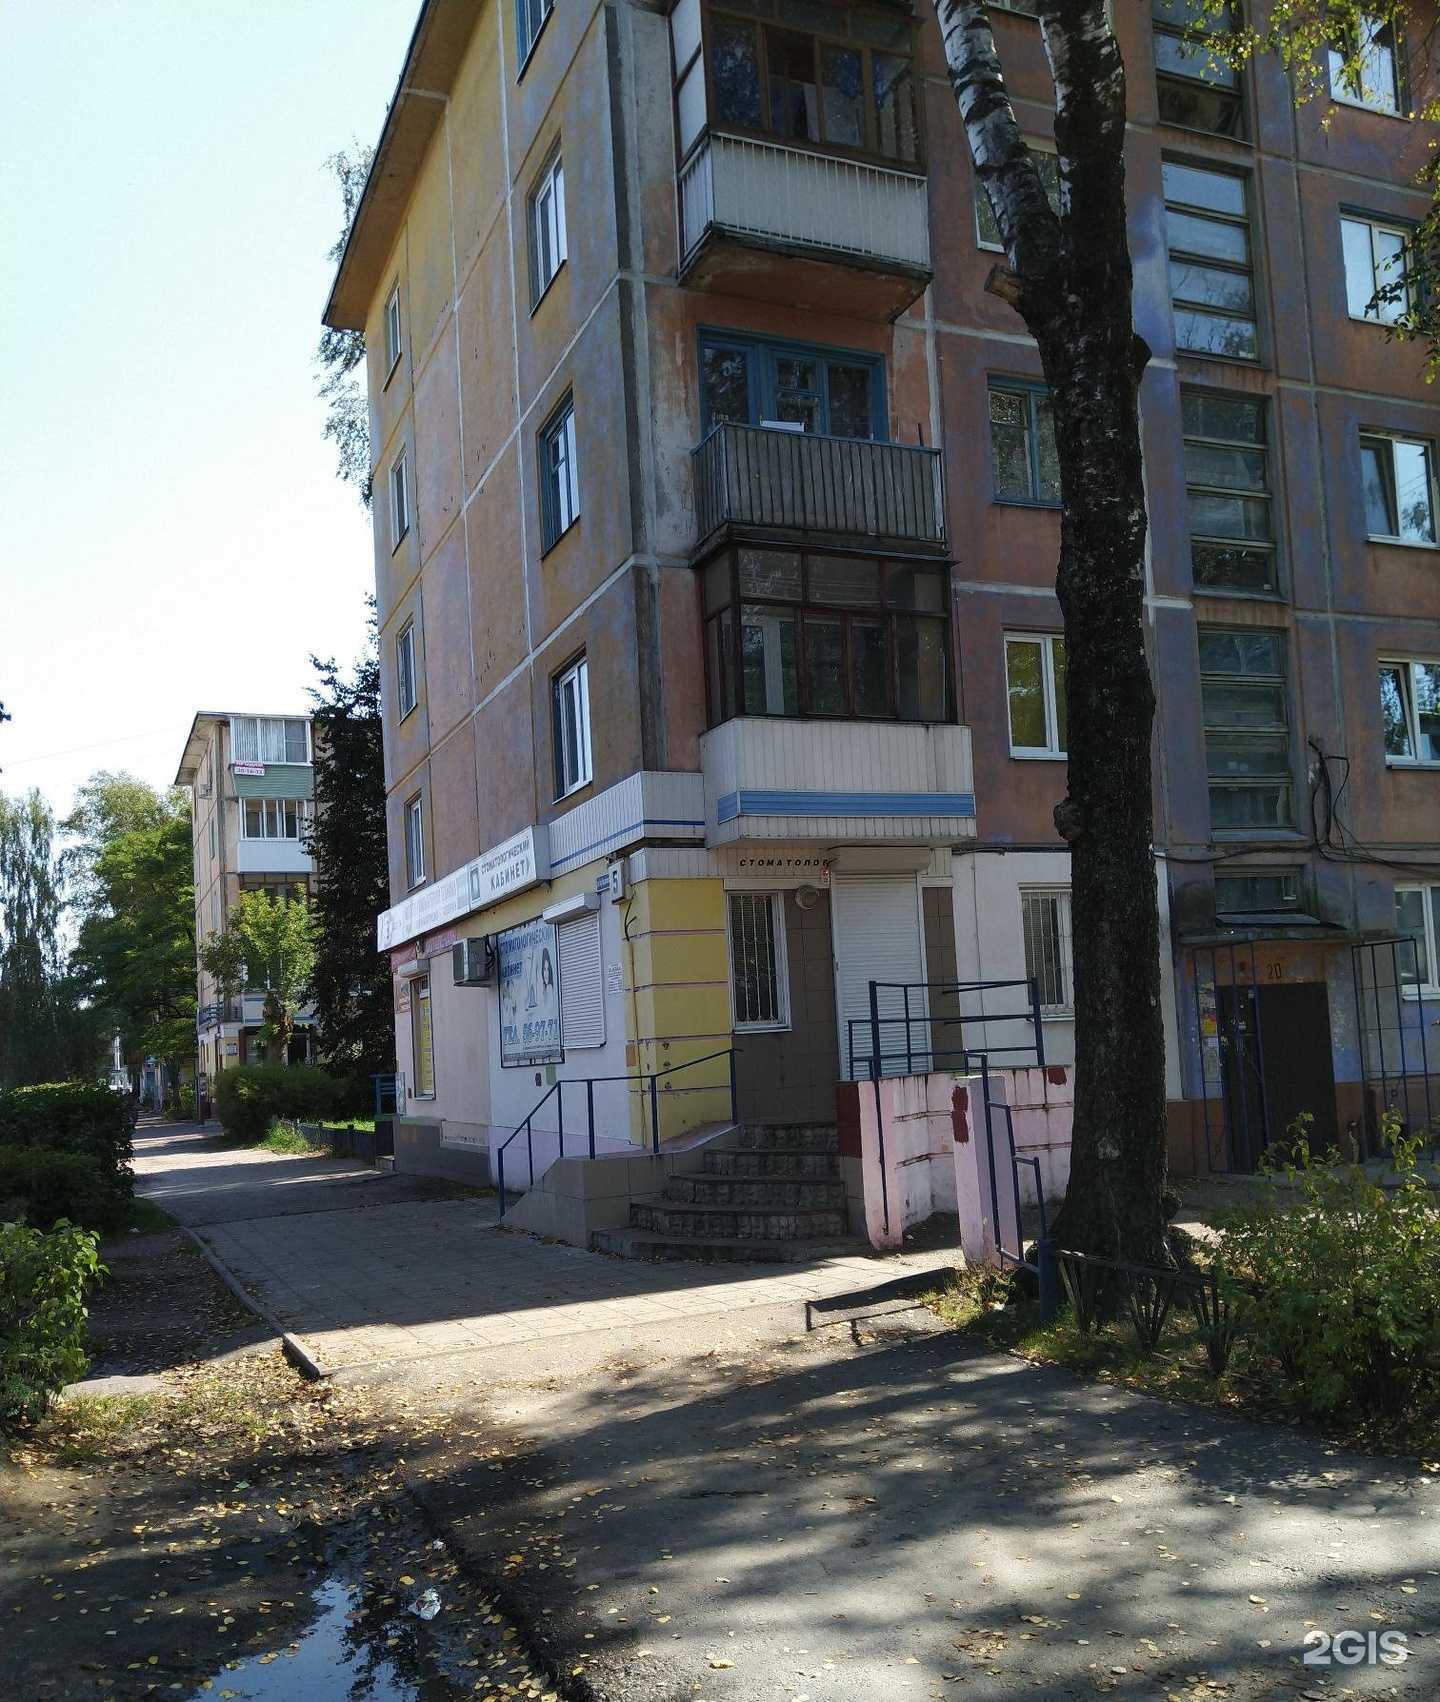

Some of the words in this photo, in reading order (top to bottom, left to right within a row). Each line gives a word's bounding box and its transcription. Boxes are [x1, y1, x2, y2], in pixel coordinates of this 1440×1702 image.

[491, 859, 525, 891] КАБИНЕТ
[612, 870, 618, 894] 5
[1265, 962, 1281, 979] 20
